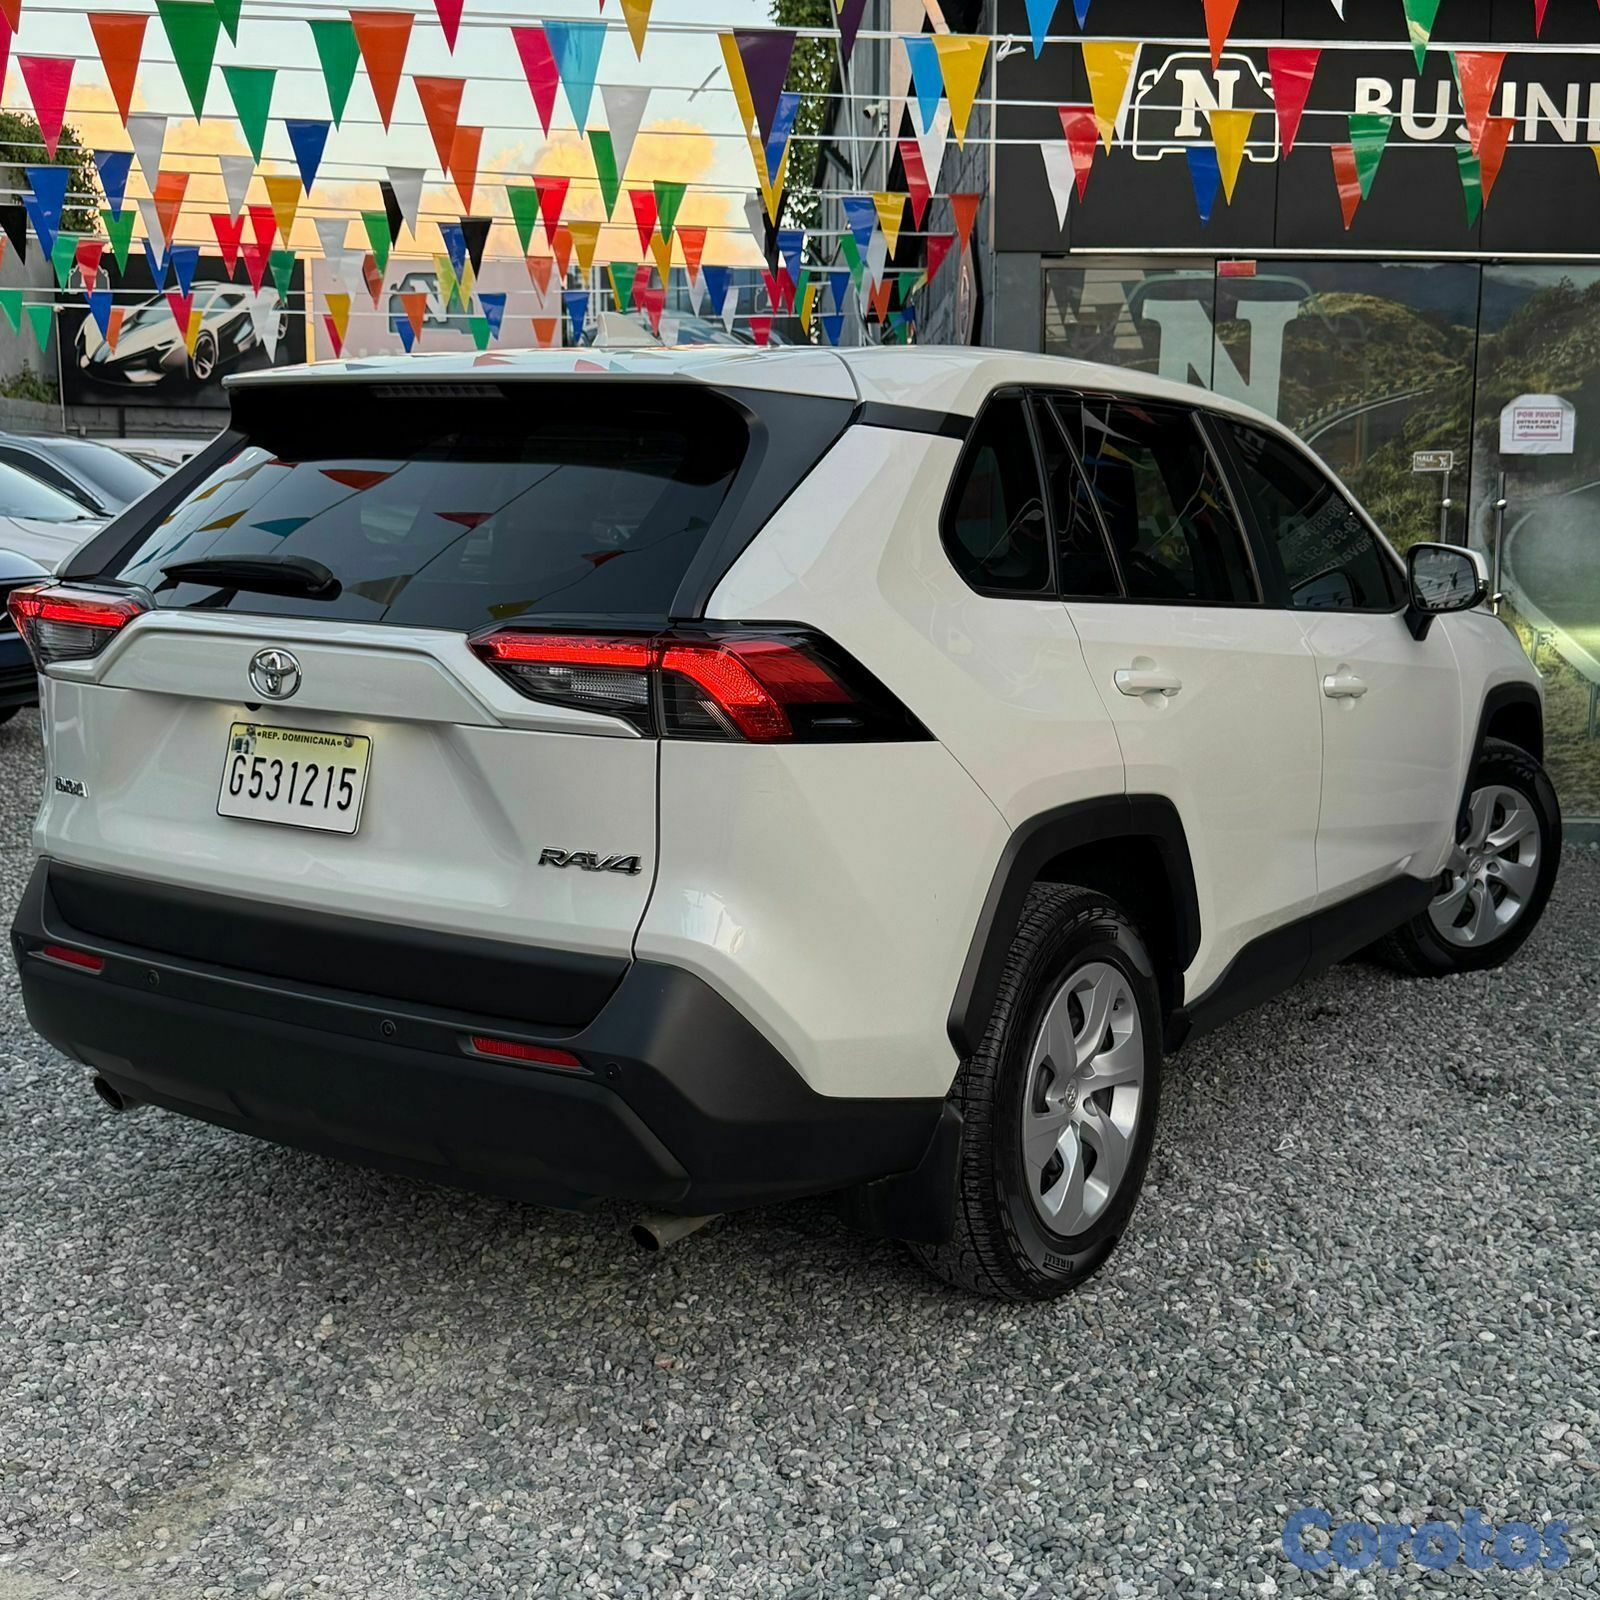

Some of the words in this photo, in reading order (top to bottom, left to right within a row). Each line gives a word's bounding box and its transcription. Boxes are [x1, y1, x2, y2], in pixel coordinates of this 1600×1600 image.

[1355, 77, 1600, 143] BUIN
[261, 731, 280, 741] REP.
[282, 733, 336, 746] DOMINICANA
[229, 755, 357, 810] G531215
[538, 846, 642, 876] RAV4
[1043, 1253, 1074, 1275] PIRELLI
